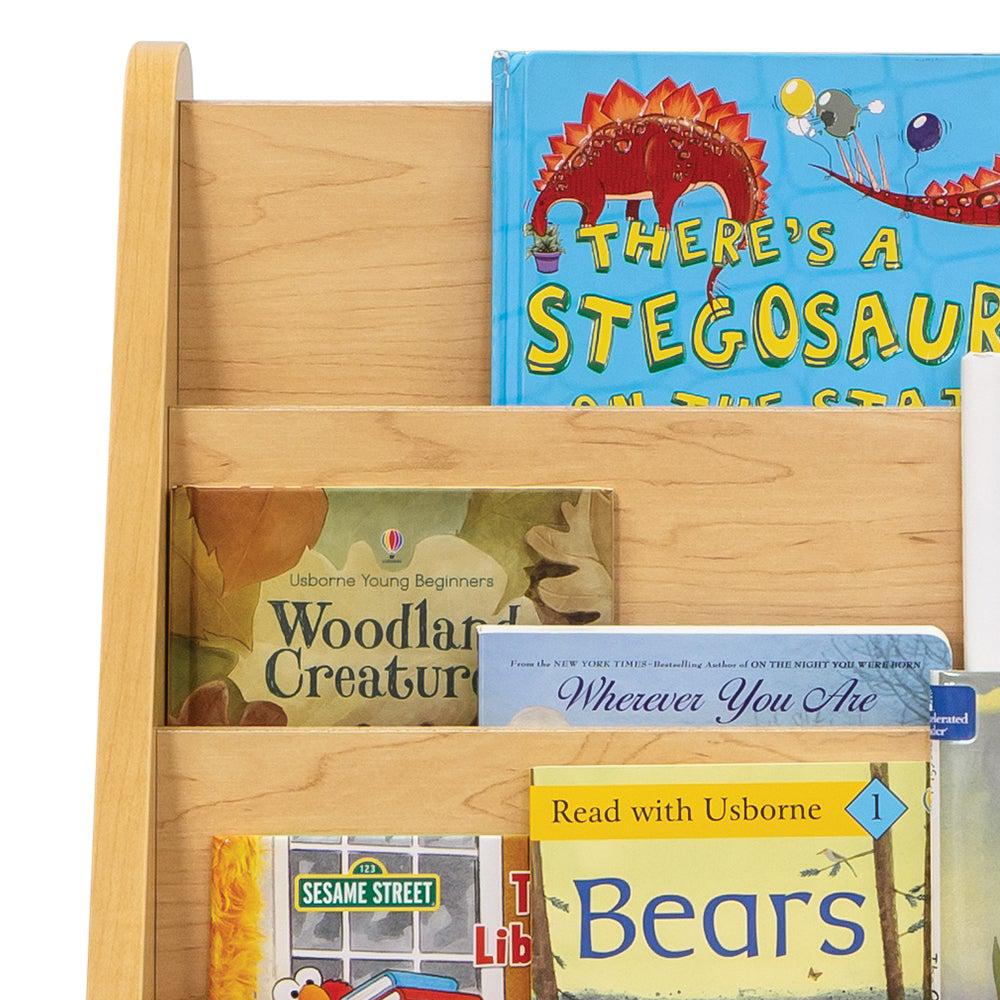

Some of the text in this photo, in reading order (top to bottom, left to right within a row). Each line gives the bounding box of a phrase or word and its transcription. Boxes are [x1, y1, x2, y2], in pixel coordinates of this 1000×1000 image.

[576, 217, 902, 273] THERE'S A
[289, 573, 494, 591] Usborne Young Beginners
[265, 647, 479, 700] Creatur
[510, 660, 534, 668] From
[537, 659, 551, 668] the
[554, 660, 577, 668] NEW
[581, 660, 610, 668] YORK
[705, 660, 736, 668] Author
[739, 660, 748, 668] of
[751, 660, 766, 669] ON
[769, 660, 791, 669] THE
[794, 660, 829, 669] NIGHT
[832, 660, 857, 669] YOU
[858, 660, 889, 669] WERE
[890, 660, 921, 669] BORN
[557, 676, 877, 724] Wherever You Are
[551, 797, 821, 824] Read with Usborne
[870, 794, 882, 820] 1
[359, 864, 376, 874] 123
[302, 881, 433, 904] SESAME STREET
[572, 878, 868, 958] Bears
